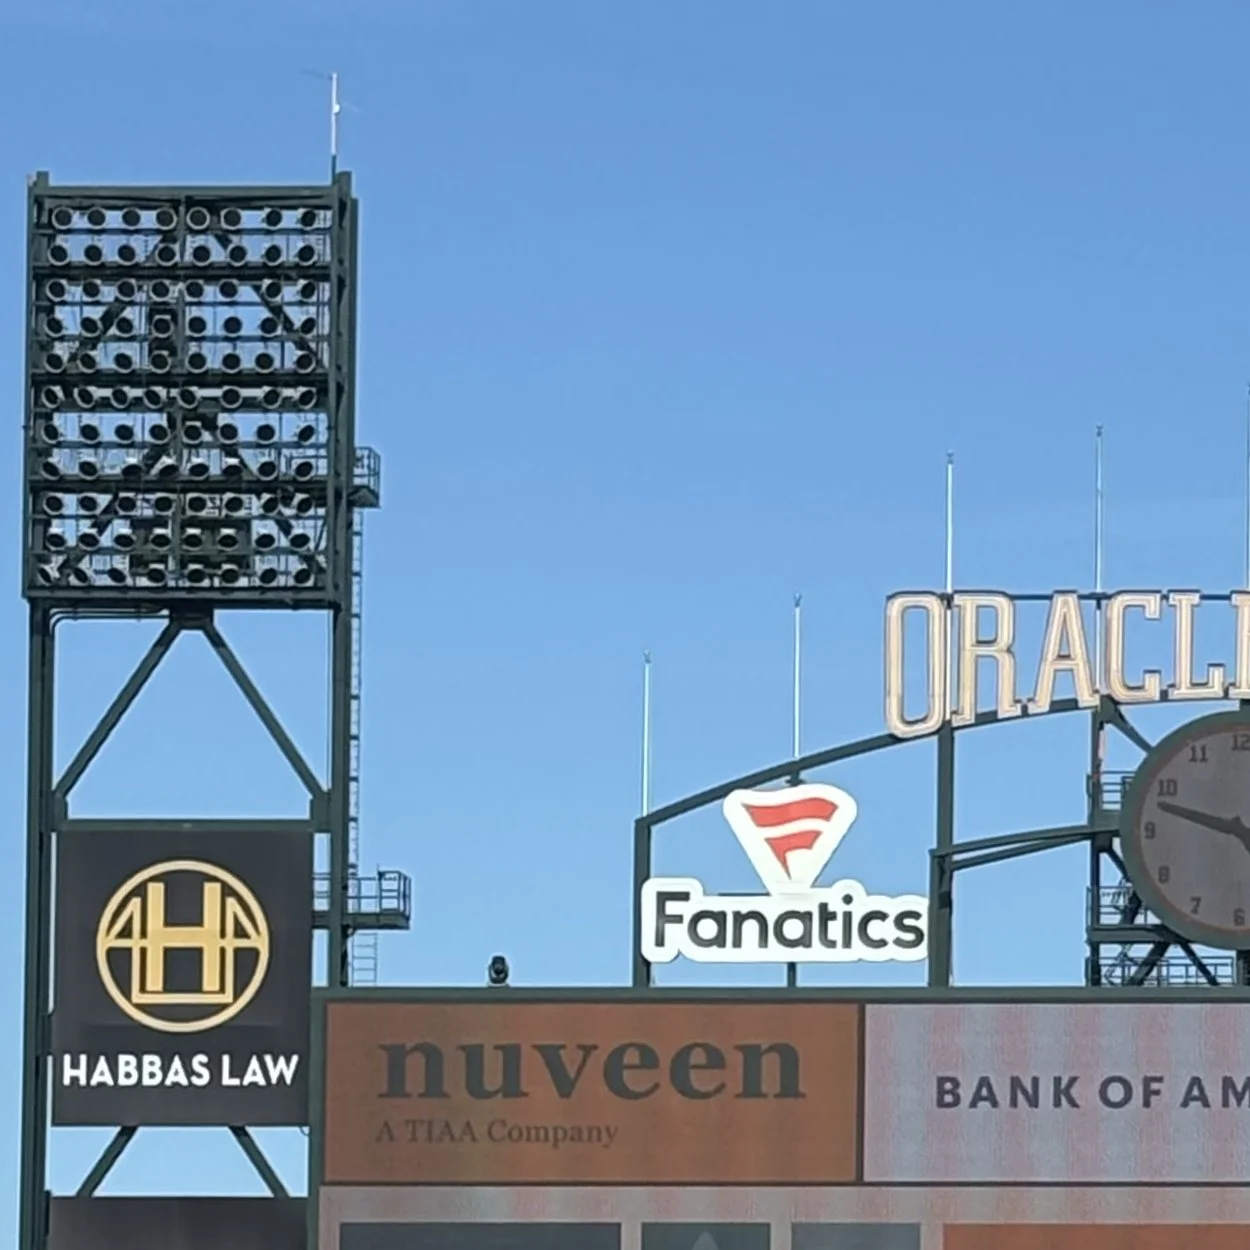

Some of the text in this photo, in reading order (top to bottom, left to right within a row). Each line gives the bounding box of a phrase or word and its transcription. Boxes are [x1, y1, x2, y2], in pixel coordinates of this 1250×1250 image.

[1231, 734, 1250, 751] 12
[1188, 745, 1208, 762] 11
[1157, 779, 1177, 796] 10
[1144, 822, 1155, 839] 9
[1158, 866, 1170, 883] 8
[1190, 897, 1202, 914] 7
[653, 890, 925, 950] Fanatics
[1234, 909, 1245, 926] 6
[63, 1054, 299, 1087] HABBAS LAW
[377, 1040, 806, 1101] nuveen
[935, 1075, 1080, 1109] BANK
[1098, 1075, 1165, 1109] OF
[376, 1120, 619, 1148] A TIAA Company
